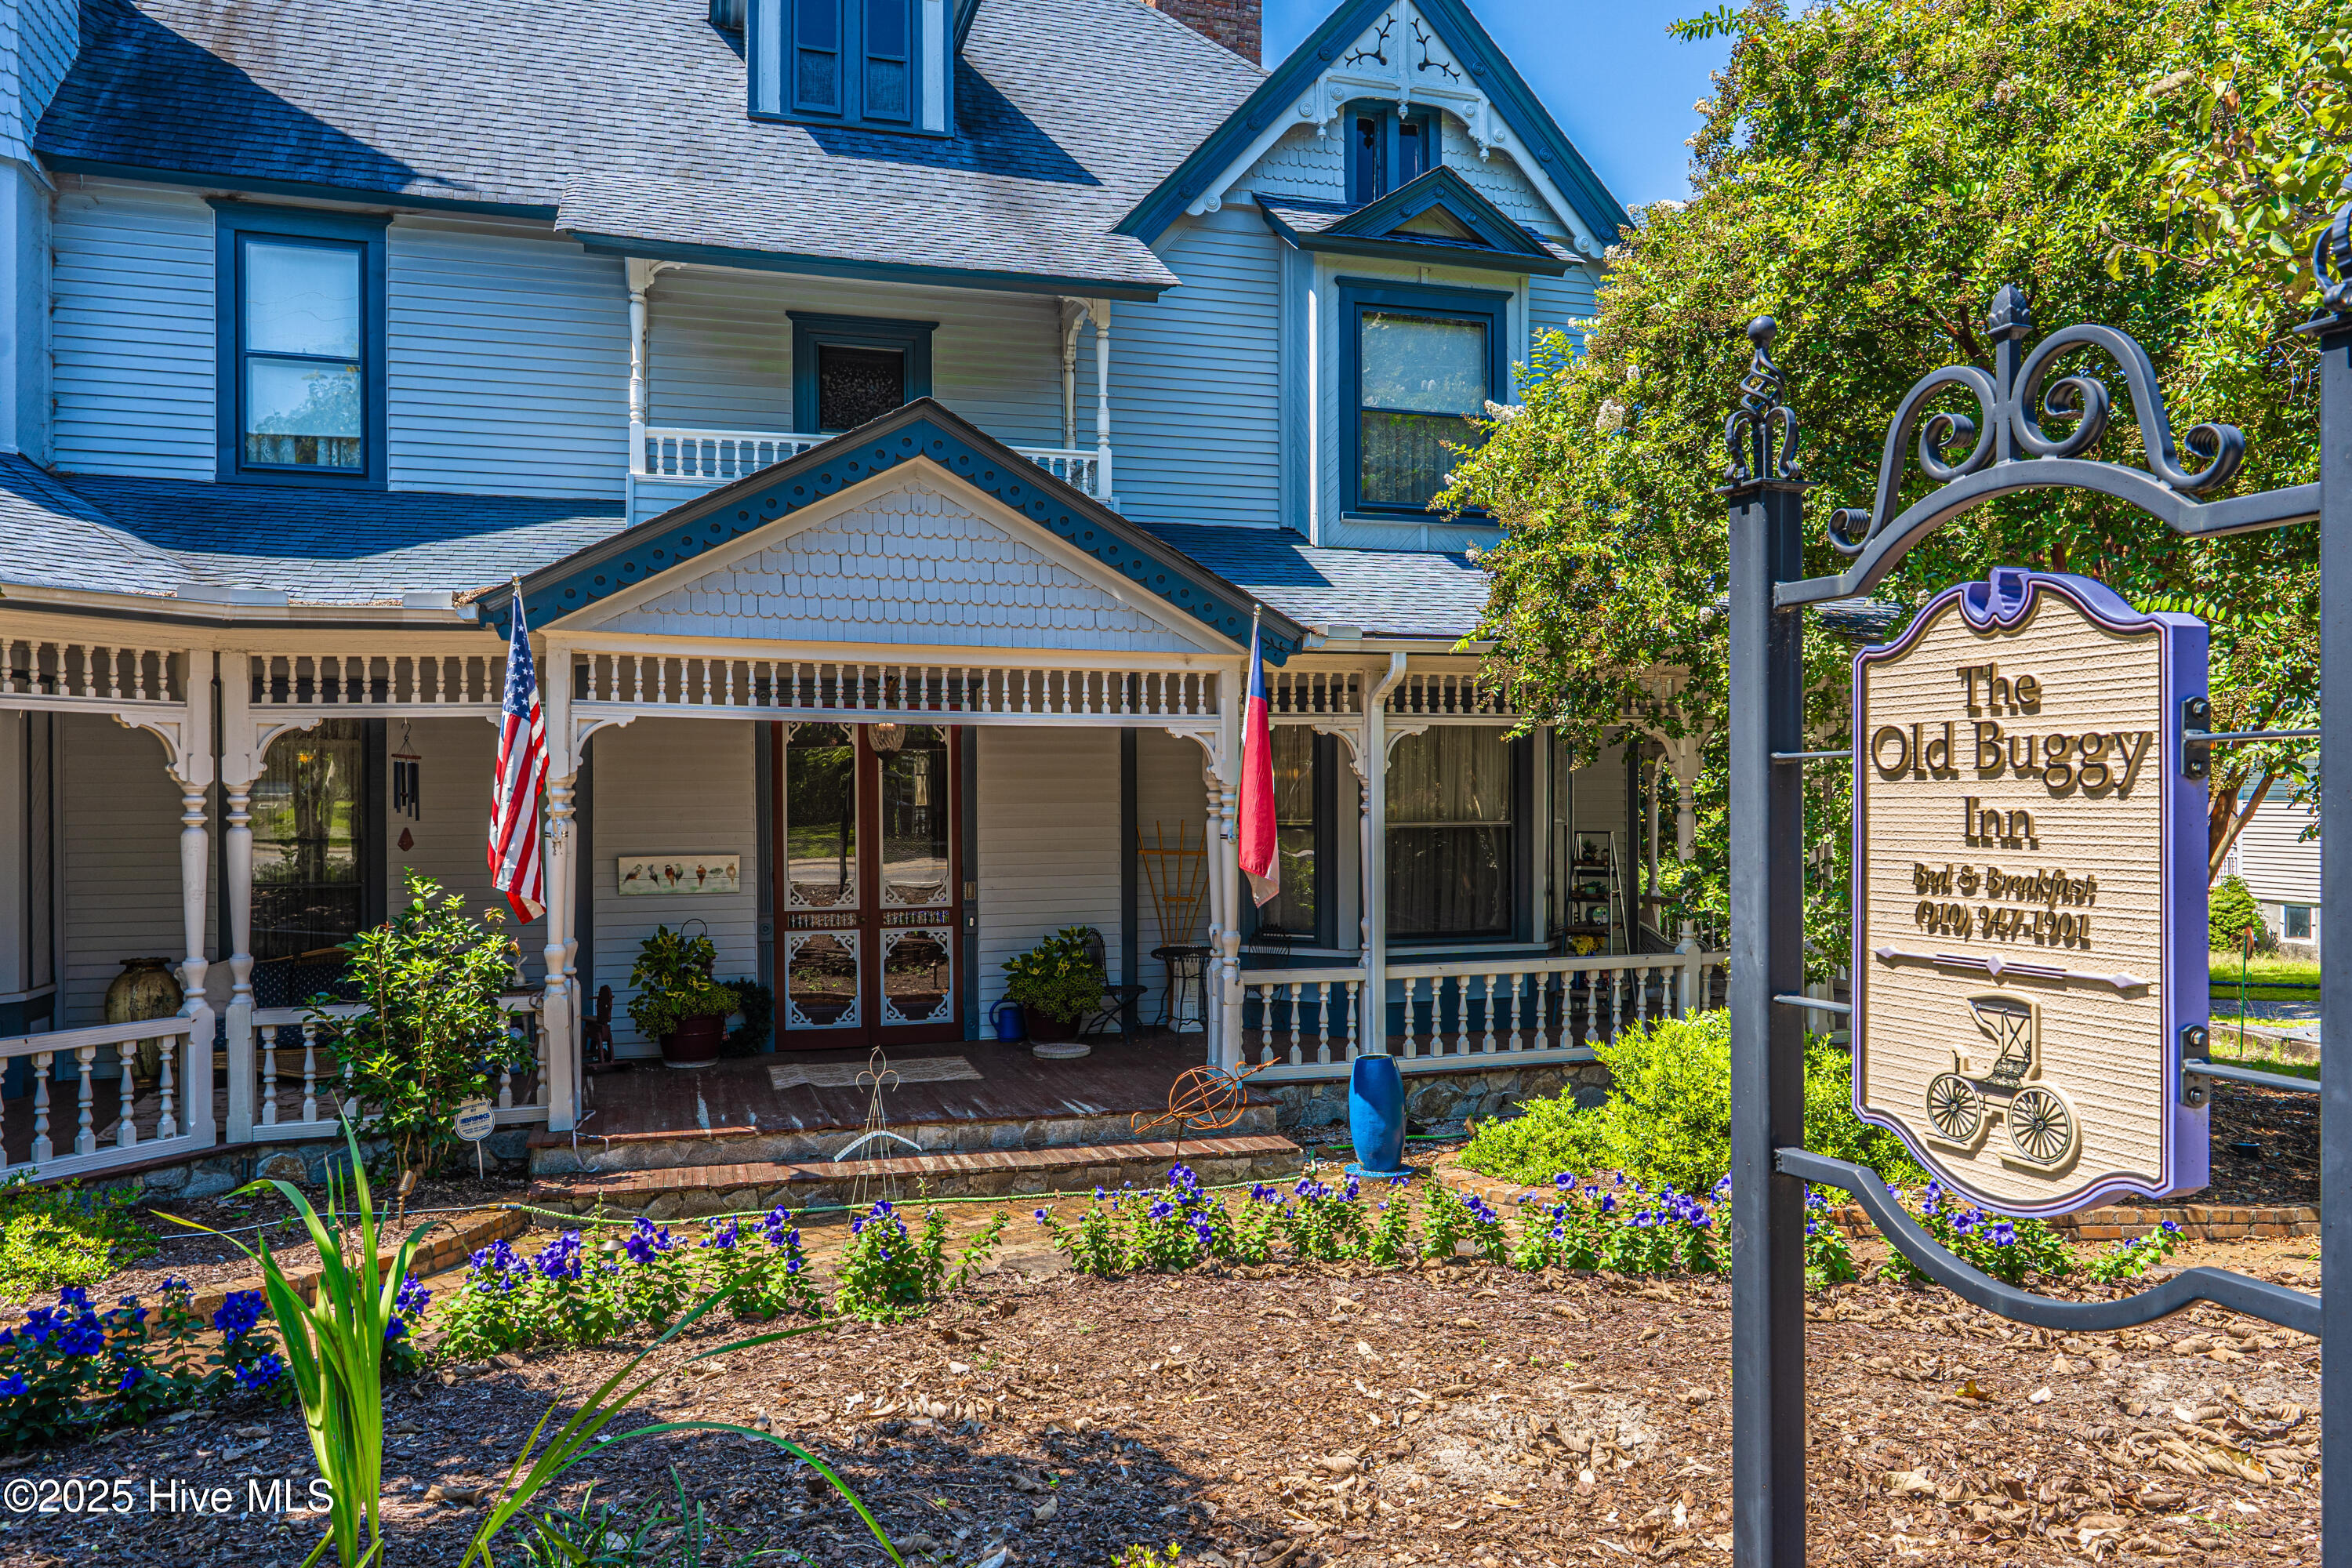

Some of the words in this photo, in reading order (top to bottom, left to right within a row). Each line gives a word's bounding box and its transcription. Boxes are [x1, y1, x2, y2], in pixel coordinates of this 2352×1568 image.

[1957, 662, 2039, 708] The
[1871, 720, 1954, 772] Old
[1971, 720, 2153, 790] Buggy
[1962, 796, 2038, 840] Inn
[1911, 862, 1953, 888] Bed
[1957, 864, 1978, 889] &
[1984, 866, 2096, 905] Breakfast
[1915, 900, 1969, 931] (910)
[1977, 906, 2092, 940] 947-1901
